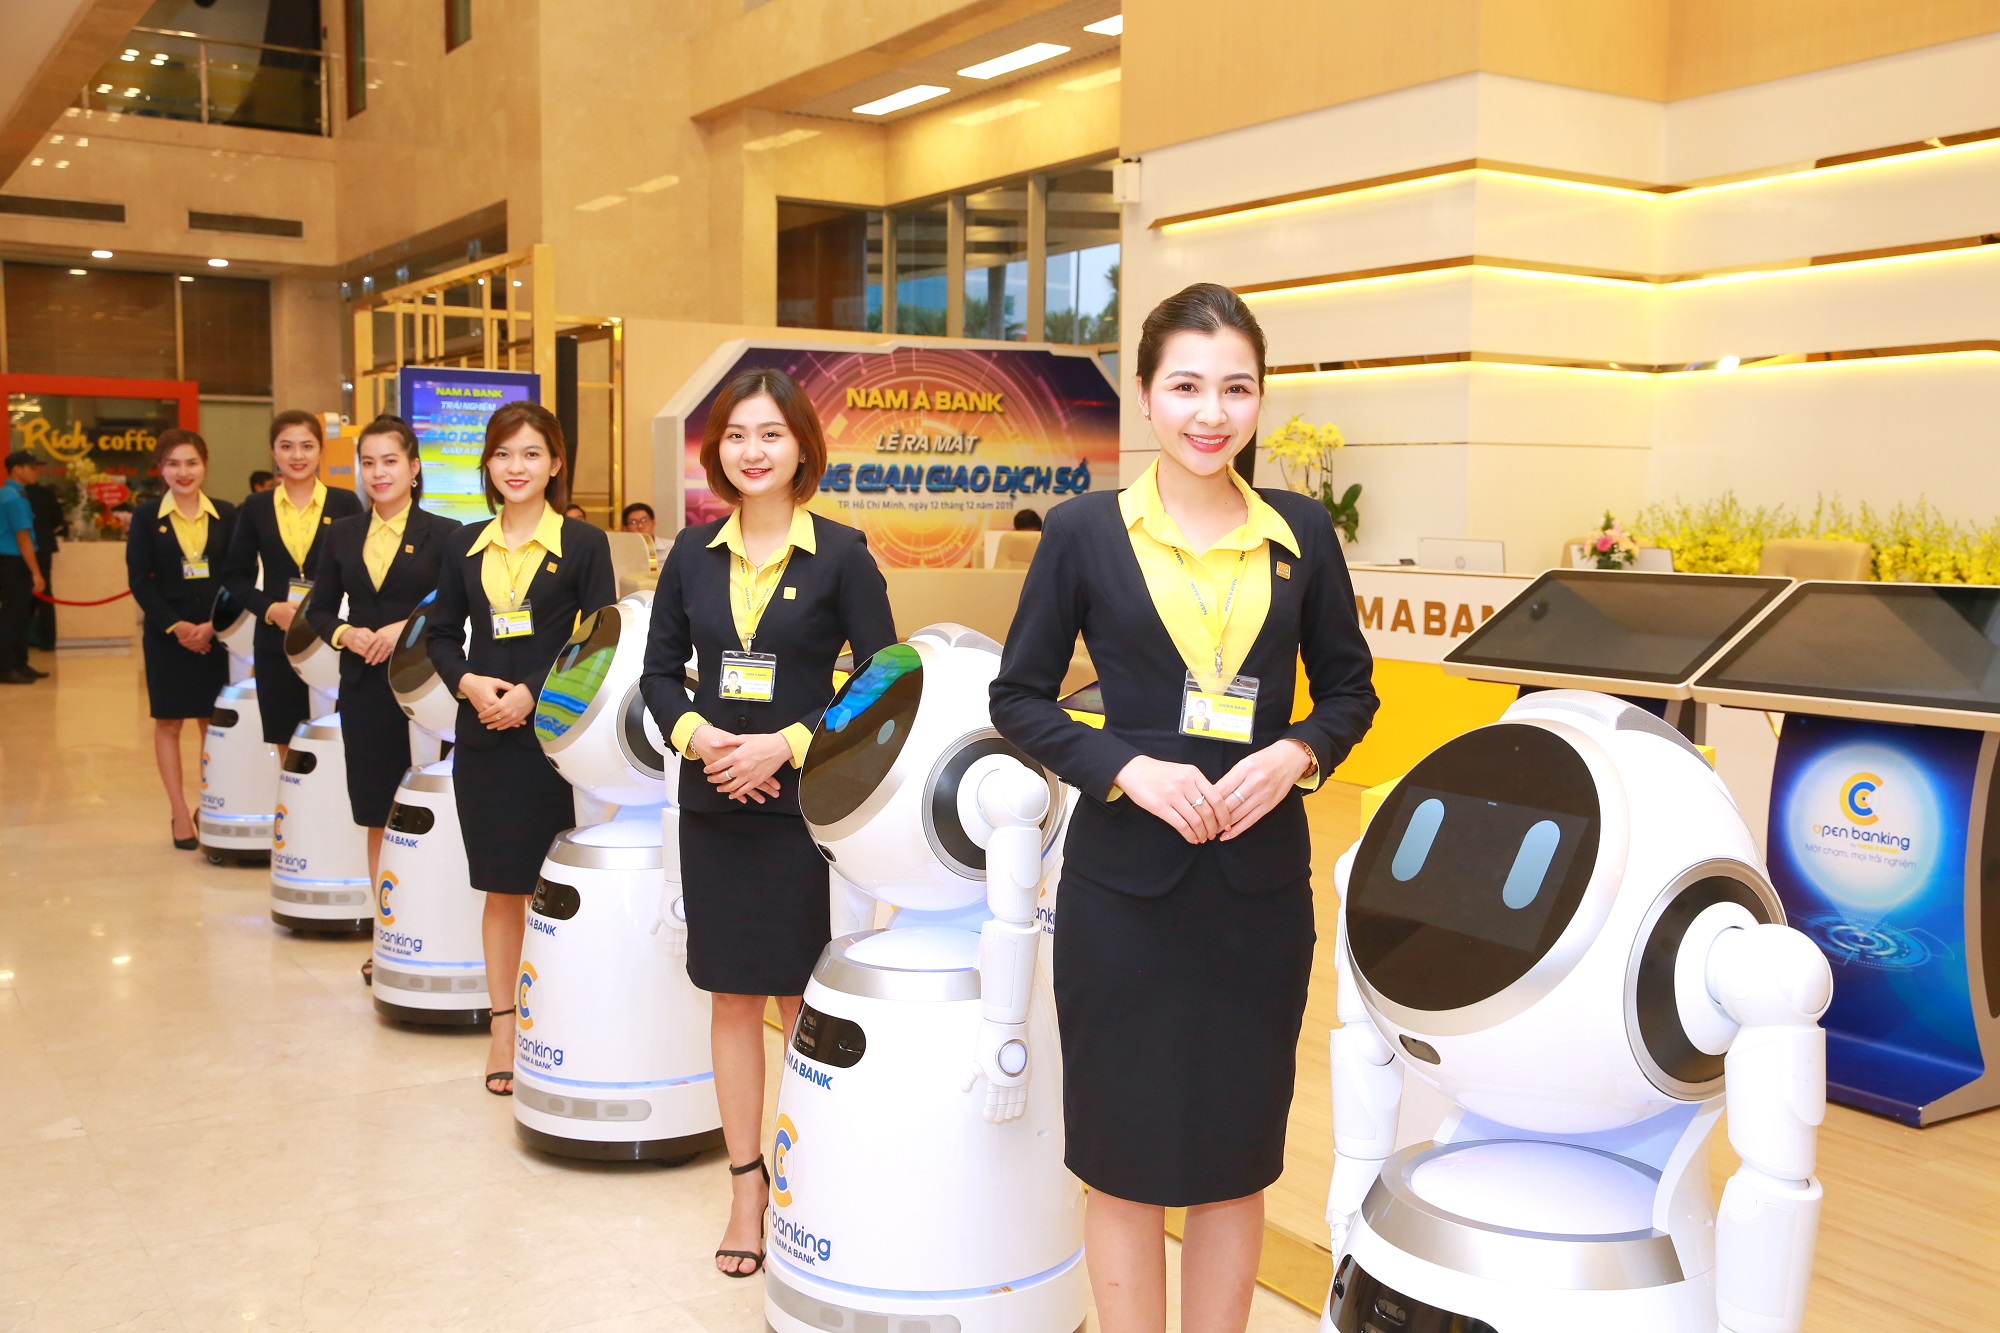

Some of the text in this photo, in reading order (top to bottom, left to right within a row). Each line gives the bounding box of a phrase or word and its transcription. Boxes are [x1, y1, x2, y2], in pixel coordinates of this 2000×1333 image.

[436, 387, 503, 399] NAM A BANK
[846, 387, 1004, 412] NAM A BANK
[16, 417, 95, 462] Rich
[901, 434, 930, 451] RA
[855, 463, 923, 492] GIAN
[925, 464, 991, 493] GIAO
[992, 465, 1051, 497] DỊCH
[1052, 457, 1090, 494] SỐ
[930, 501, 938, 510] 12
[966, 501, 974, 510] 12
[996, 501, 1014, 510] 2019
[395, 836, 418, 848] BANK
[1851, 826, 1910, 851] banking
[533, 919, 557, 937] BANK
[517, 1033, 563, 1066] banking
[534, 1059, 552, 1070] BANK
[799, 1062, 833, 1090] BANK
[772, 1204, 831, 1262] banking
[775, 1235, 787, 1252] NAM
[787, 1246, 792, 1255] A
[793, 1248, 816, 1267] BANK
